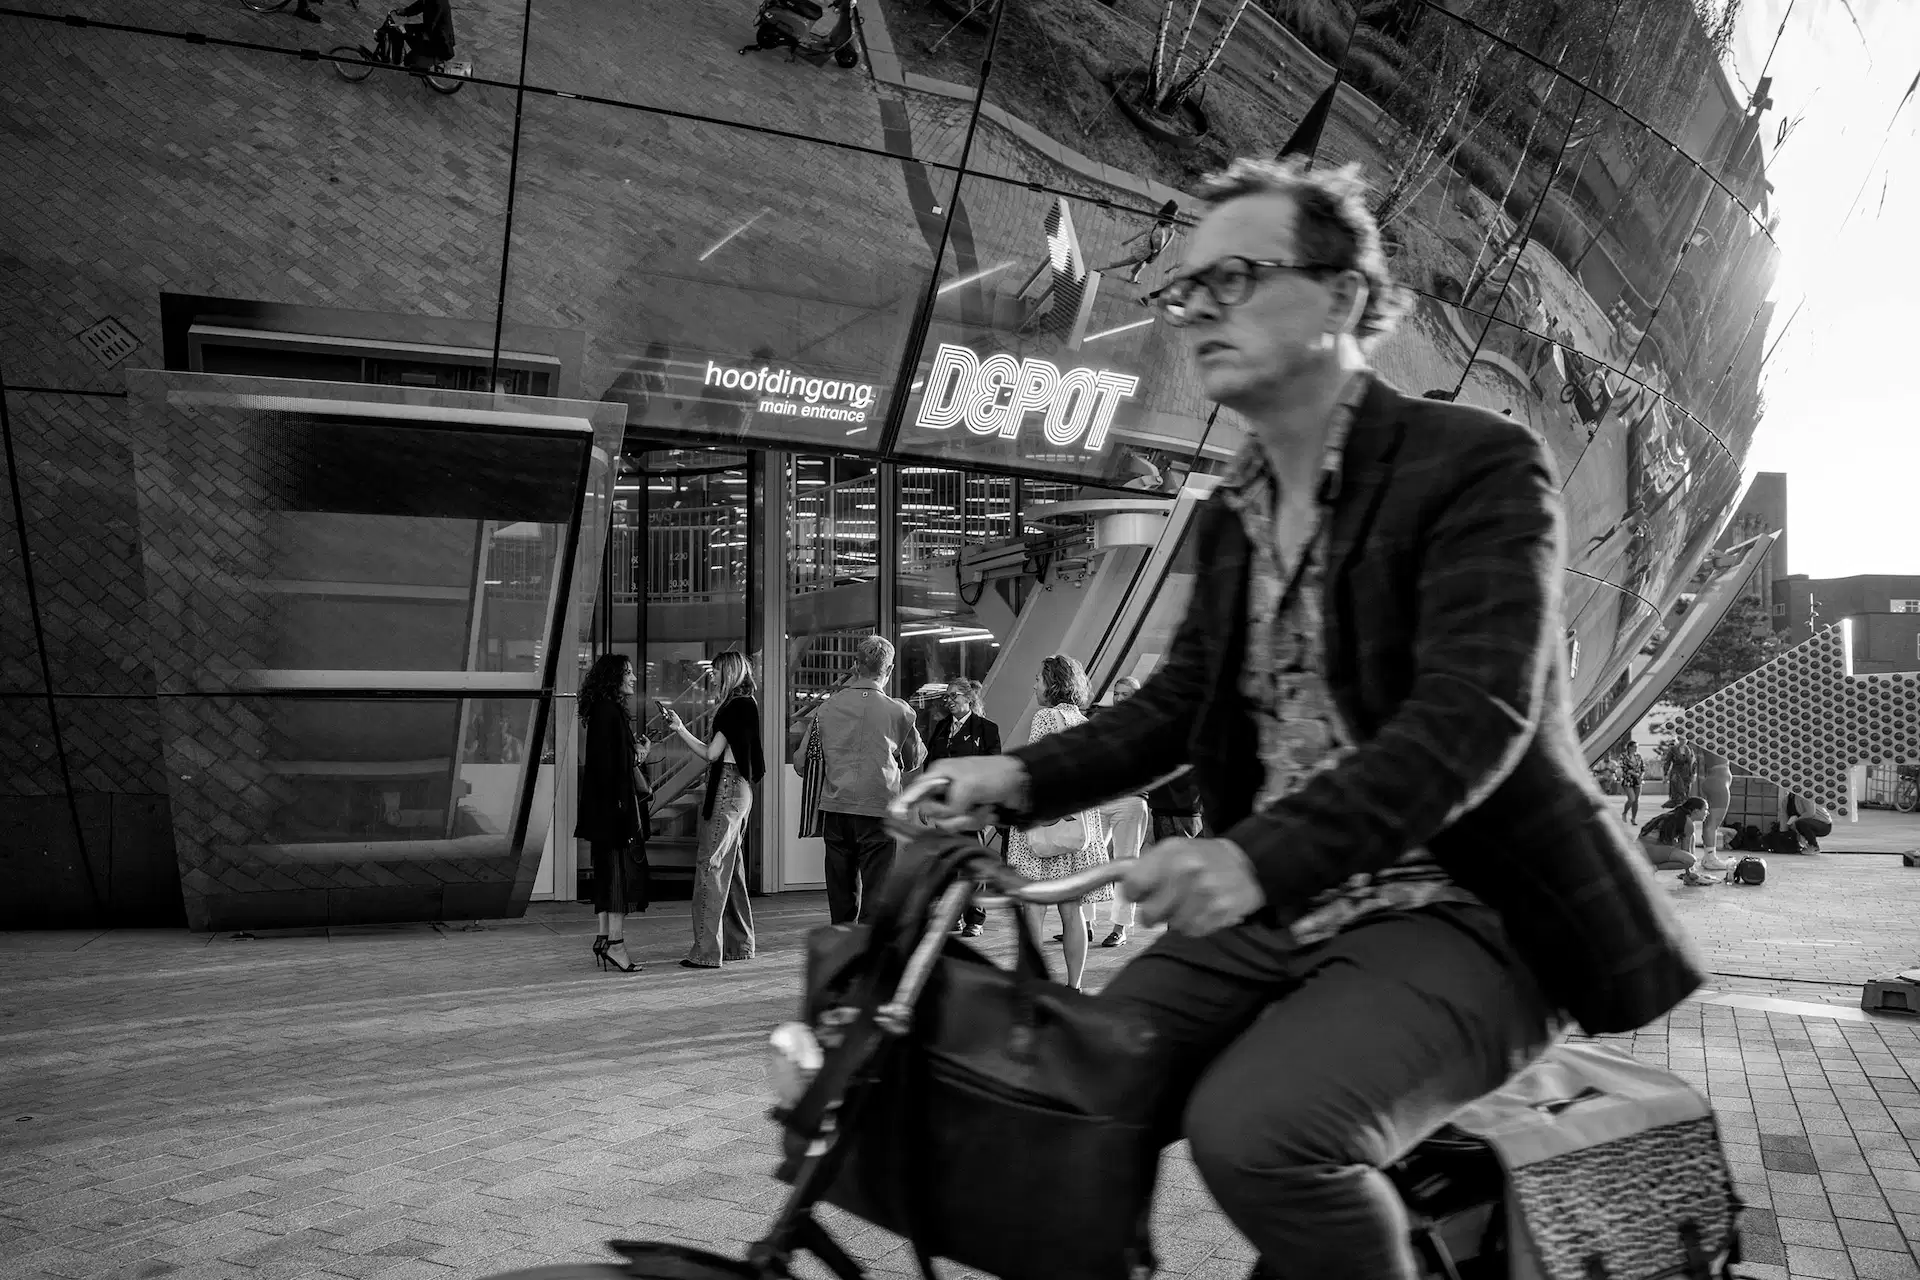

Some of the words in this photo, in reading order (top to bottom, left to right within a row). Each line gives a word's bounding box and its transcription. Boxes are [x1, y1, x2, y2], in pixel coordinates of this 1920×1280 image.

[704, 360, 874, 409] hoofdingang
[915, 343, 1140, 451] DEPOT
[758, 398, 798, 416] main
[800, 404, 866, 423] entrance
